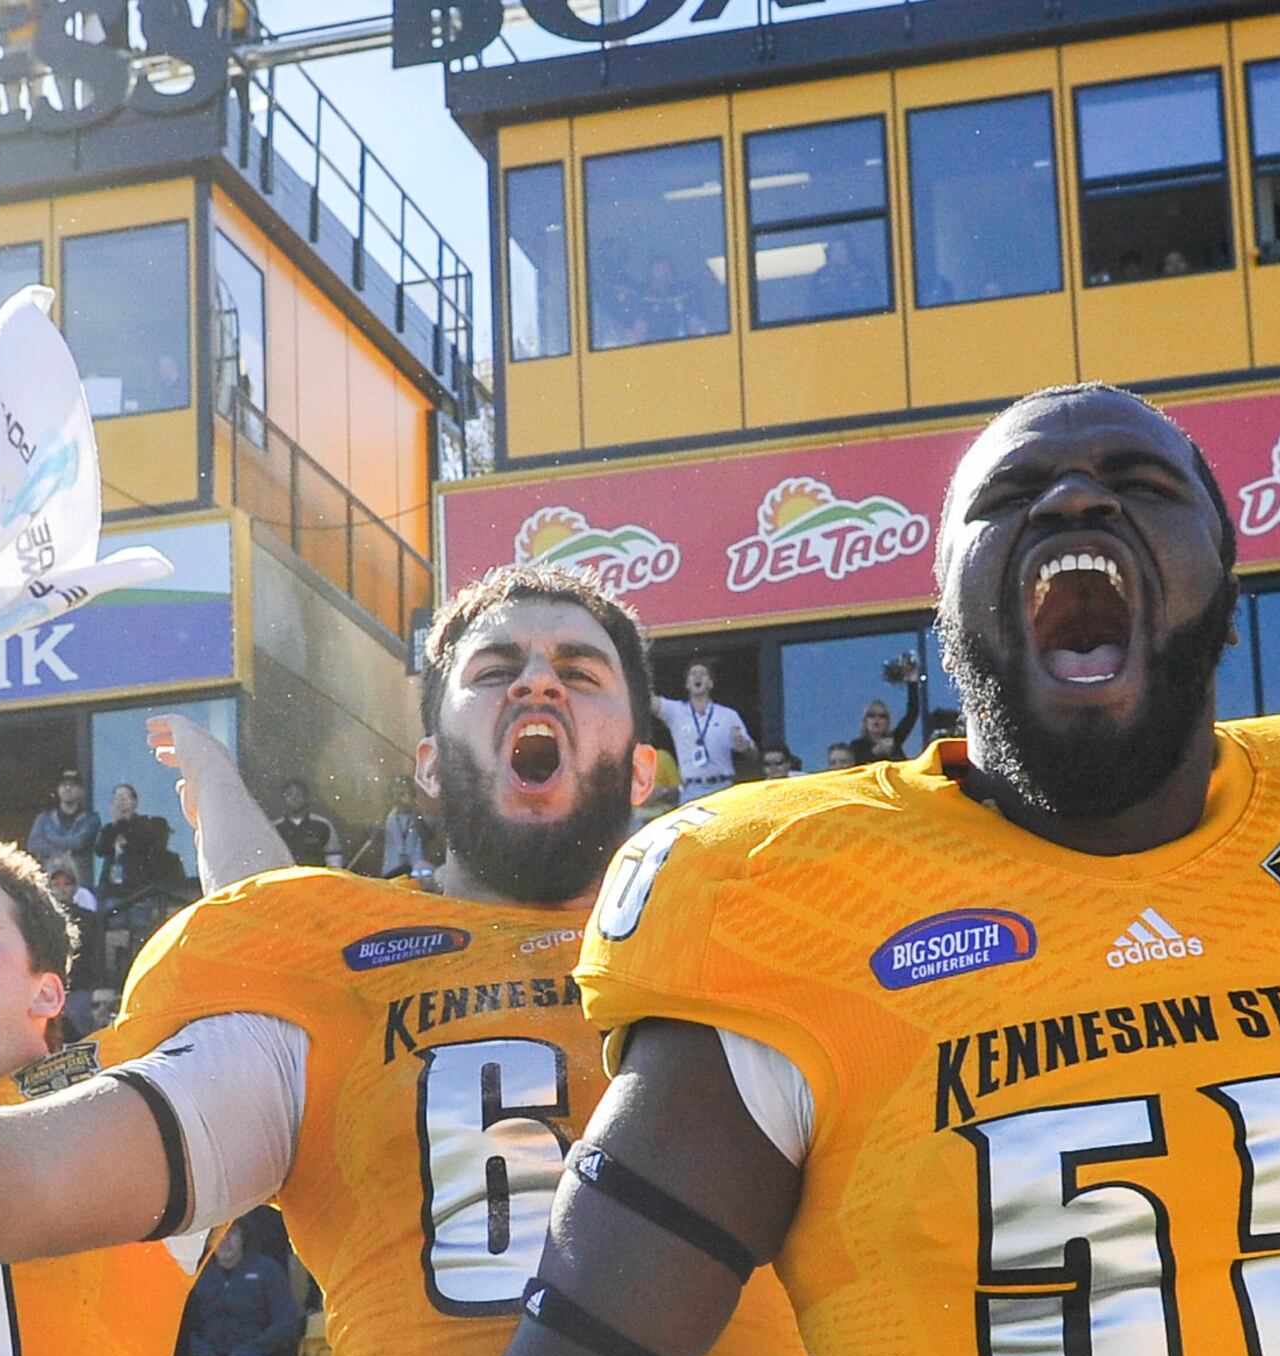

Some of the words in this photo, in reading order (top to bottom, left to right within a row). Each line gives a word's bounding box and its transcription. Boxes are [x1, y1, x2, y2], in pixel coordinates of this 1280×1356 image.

[732, 539, 821, 587] DEL
[824, 518, 926, 575] TACO
[358, 941, 386, 959] BIG
[387, 932, 445, 954] SOUTH
[519, 929, 585, 954] adid
[892, 941, 926, 970] BIG
[928, 923, 1000, 963] SOUTH
[1106, 937, 1204, 969] adidas
[910, 949, 991, 981] CONFERENCE
[382, 973, 585, 1065] KENNESA
[933, 995, 1217, 1132] KENNESAW
